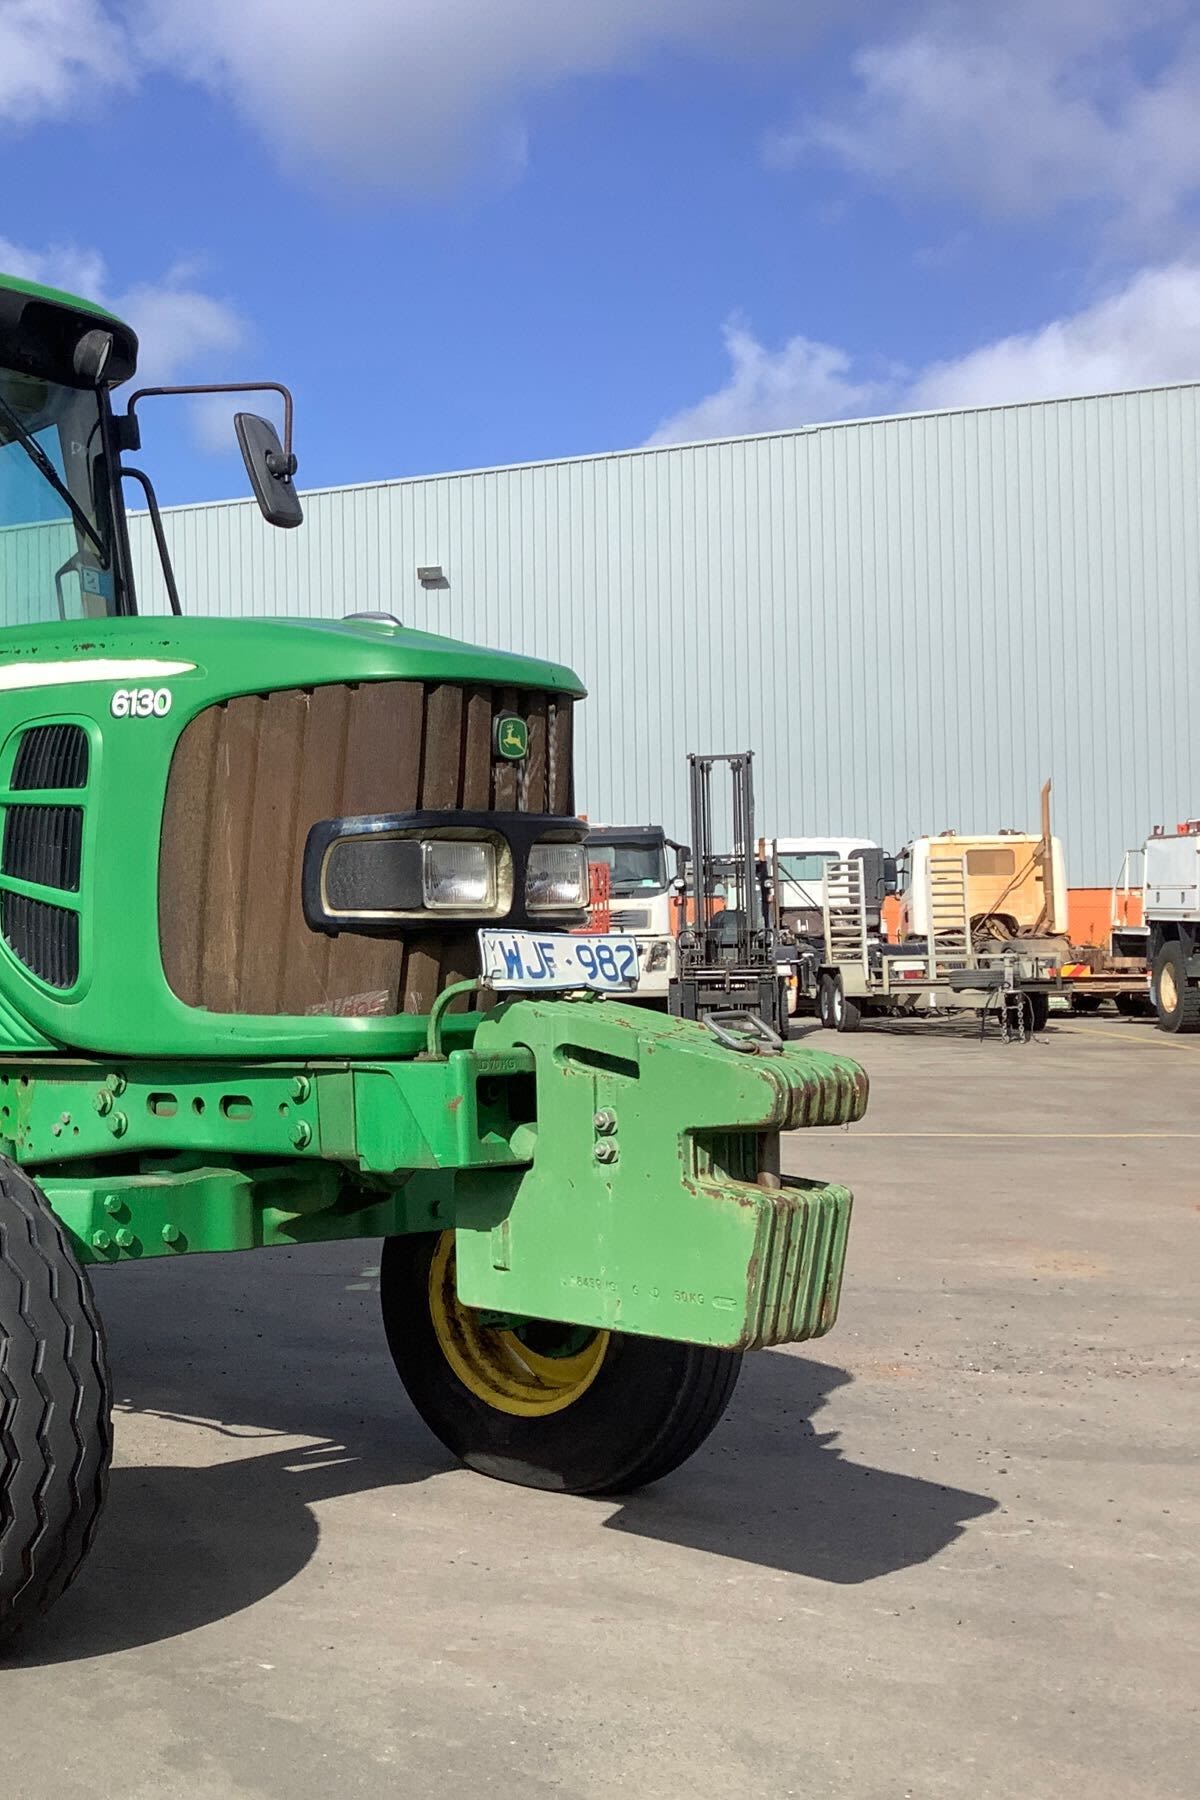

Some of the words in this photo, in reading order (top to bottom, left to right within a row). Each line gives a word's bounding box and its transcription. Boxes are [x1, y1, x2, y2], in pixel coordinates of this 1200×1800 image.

[111, 687, 172, 718] 6130
[498, 940, 555, 980] WJF
[575, 944, 635, 982] 982
